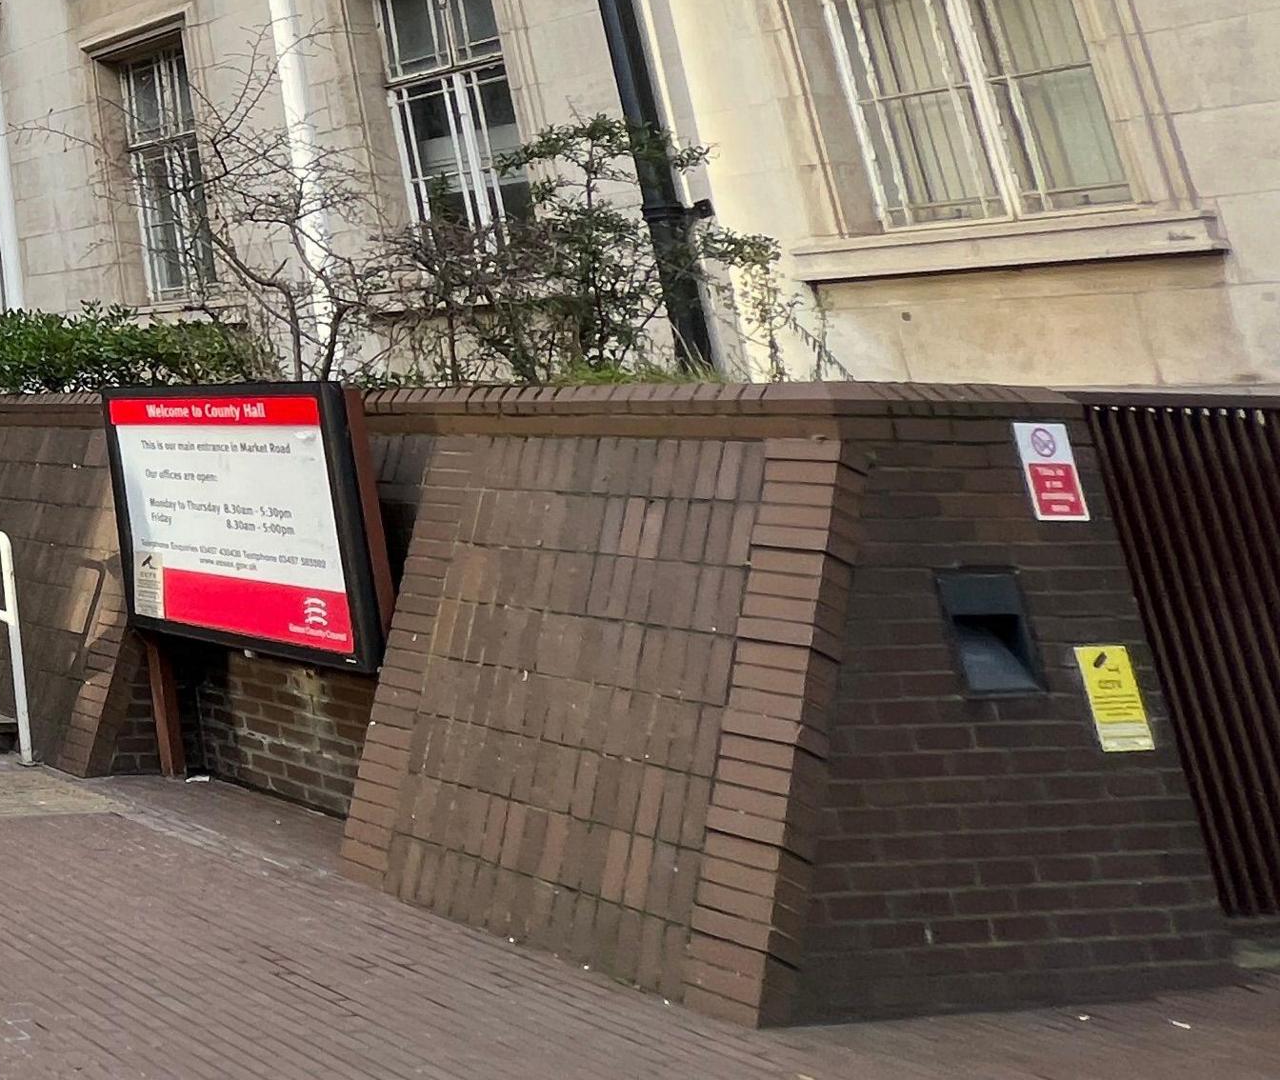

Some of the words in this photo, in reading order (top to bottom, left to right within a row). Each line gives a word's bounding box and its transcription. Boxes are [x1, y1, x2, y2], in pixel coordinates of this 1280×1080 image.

[146, 404, 189, 418] Welcome
[191, 404, 202, 418] to
[204, 403, 240, 421] County
[243, 402, 266, 418] Hall
[141, 439, 156, 450] This
[157, 440, 164, 450] is
[165, 442, 176, 451] our
[178, 441, 195, 451] main
[197, 443, 230, 452] entrance
[231, 442, 238, 452] in
[240, 442, 268, 453] Market
[269, 443, 291, 454] Road
[145, 468, 157, 479] Our
[159, 468, 182, 480] offices
[184, 472, 195, 481] are
[149, 498, 176, 512] Monday
[177, 500, 186, 510] to
[187, 500, 221, 516] Thursday
[151, 512, 172, 526] Friday
